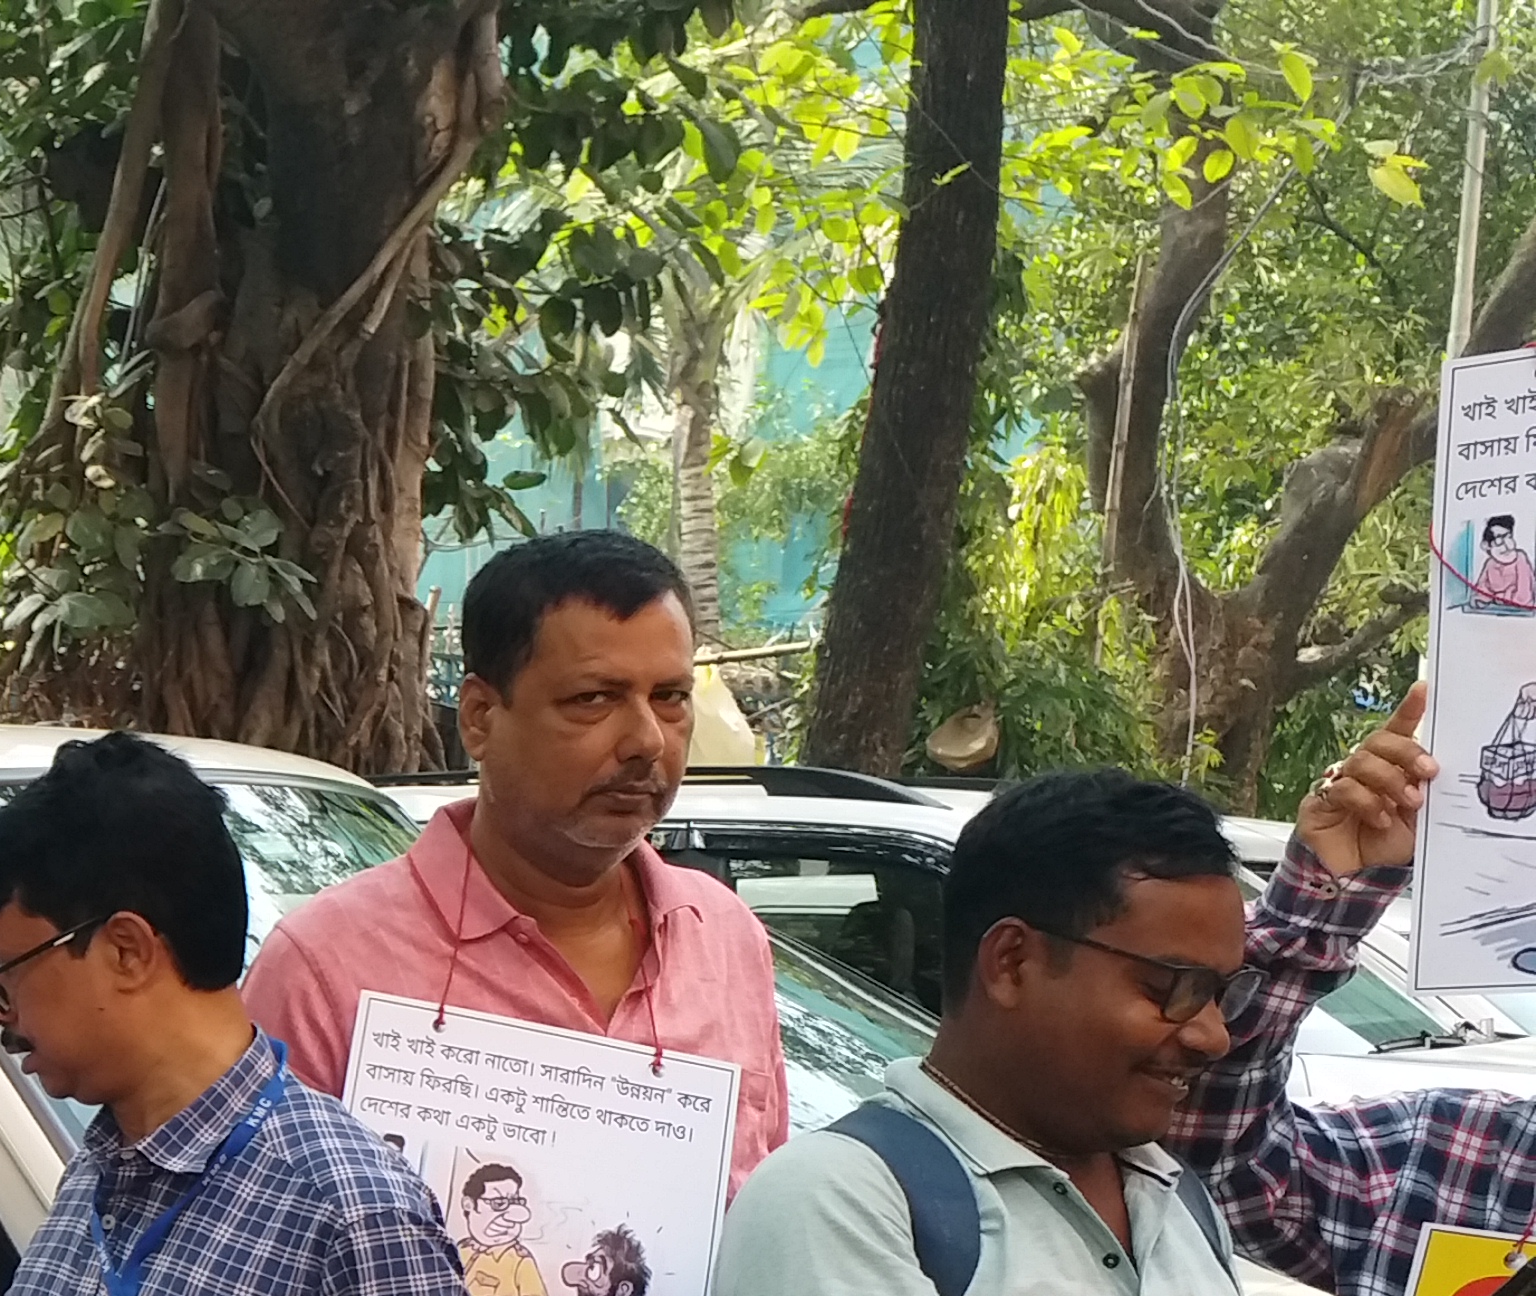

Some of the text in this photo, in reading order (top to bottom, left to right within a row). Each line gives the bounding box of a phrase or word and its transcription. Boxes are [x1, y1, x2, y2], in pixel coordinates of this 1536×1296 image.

[1461, 394, 1498, 421] খাই
[1457, 435, 1519, 461] বাসায়
[1455, 474, 1519, 501] দেশের
[372, 1029, 402, 1052] খাই
[406, 1035, 437, 1059] খাই
[439, 1043, 481, 1066] করো
[540, 1063, 606, 1092] সারাদিন
[676, 1091, 713, 1114] করে
[246, 1097, 272, 1128] KMC
[365, 1063, 416, 1087] বাসায়
[484, 1086, 528, 1115] একটু
[531, 1093, 592, 1120] শান্তিতে
[595, 1108, 651, 1133] থাকতে
[359, 1095, 412, 1120] দেশের
[416, 1104, 452, 1127] কথা
[455, 1113, 499, 1142] একটু
